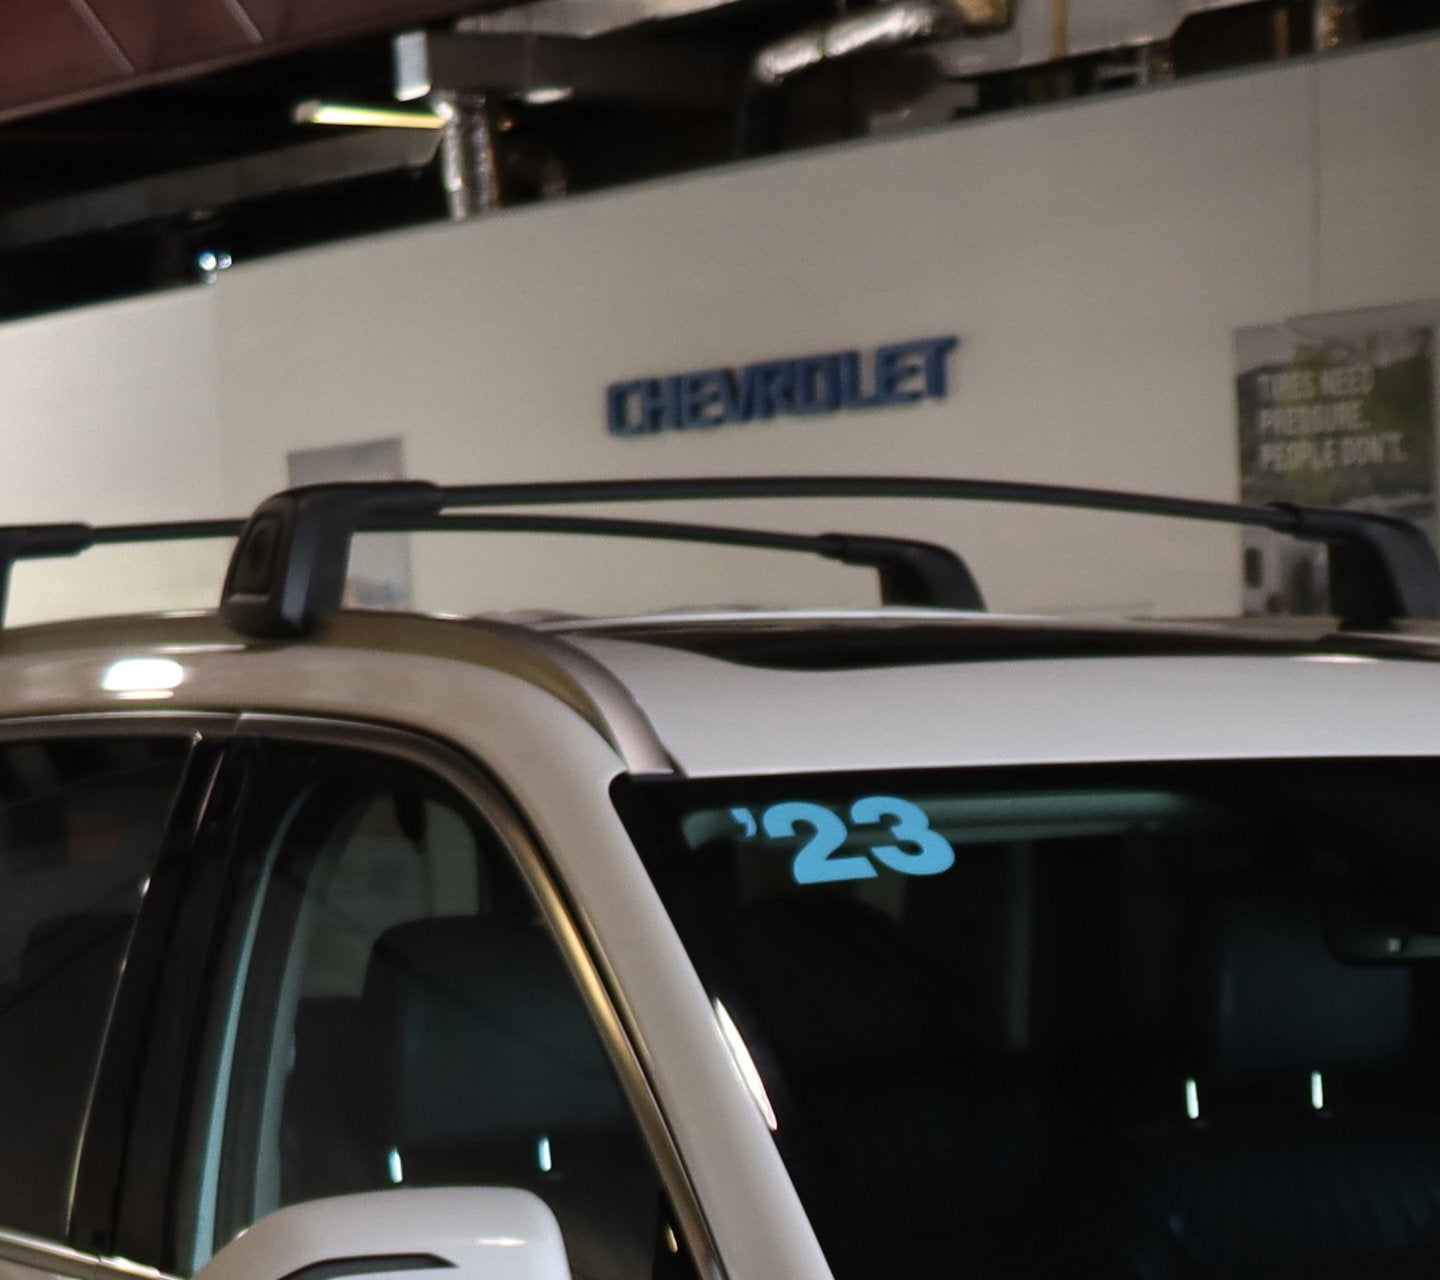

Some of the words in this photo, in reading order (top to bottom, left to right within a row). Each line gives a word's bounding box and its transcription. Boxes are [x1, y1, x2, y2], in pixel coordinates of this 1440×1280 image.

[606, 336, 960, 438] CHEVROLET
[1256, 370, 1316, 401] TIRES
[1319, 363, 1375, 396] NEED
[1258, 400, 1371, 437] PRESSURE.
[1258, 440, 1336, 474] PEOPLE
[1339, 431, 1409, 467] DON'T.
[730, 796, 955, 885] '23
